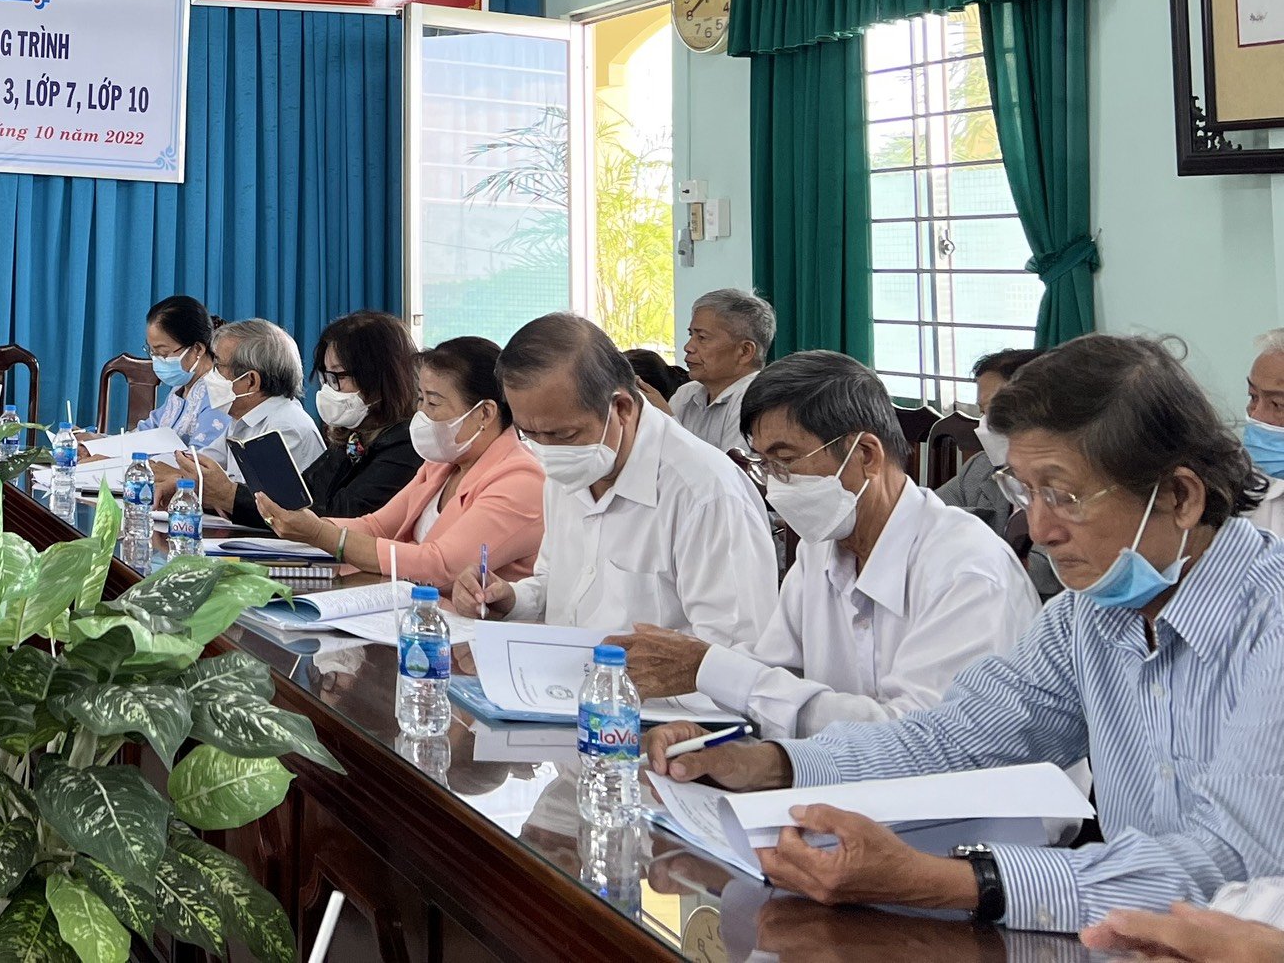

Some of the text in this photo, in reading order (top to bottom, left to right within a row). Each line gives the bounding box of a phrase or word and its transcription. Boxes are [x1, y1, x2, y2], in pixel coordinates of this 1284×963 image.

[18, 25, 70, 59] TRÌNH
[3, 78, 19, 110] 3,
[25, 73, 60, 107] LỚP
[66, 82, 81, 114] 7,
[88, 77, 122, 111] LỚP
[128, 87, 149, 113] 10
[35, 126, 54, 140] 10
[60, 128, 99, 142] năm
[105, 130, 144, 145] 2022
